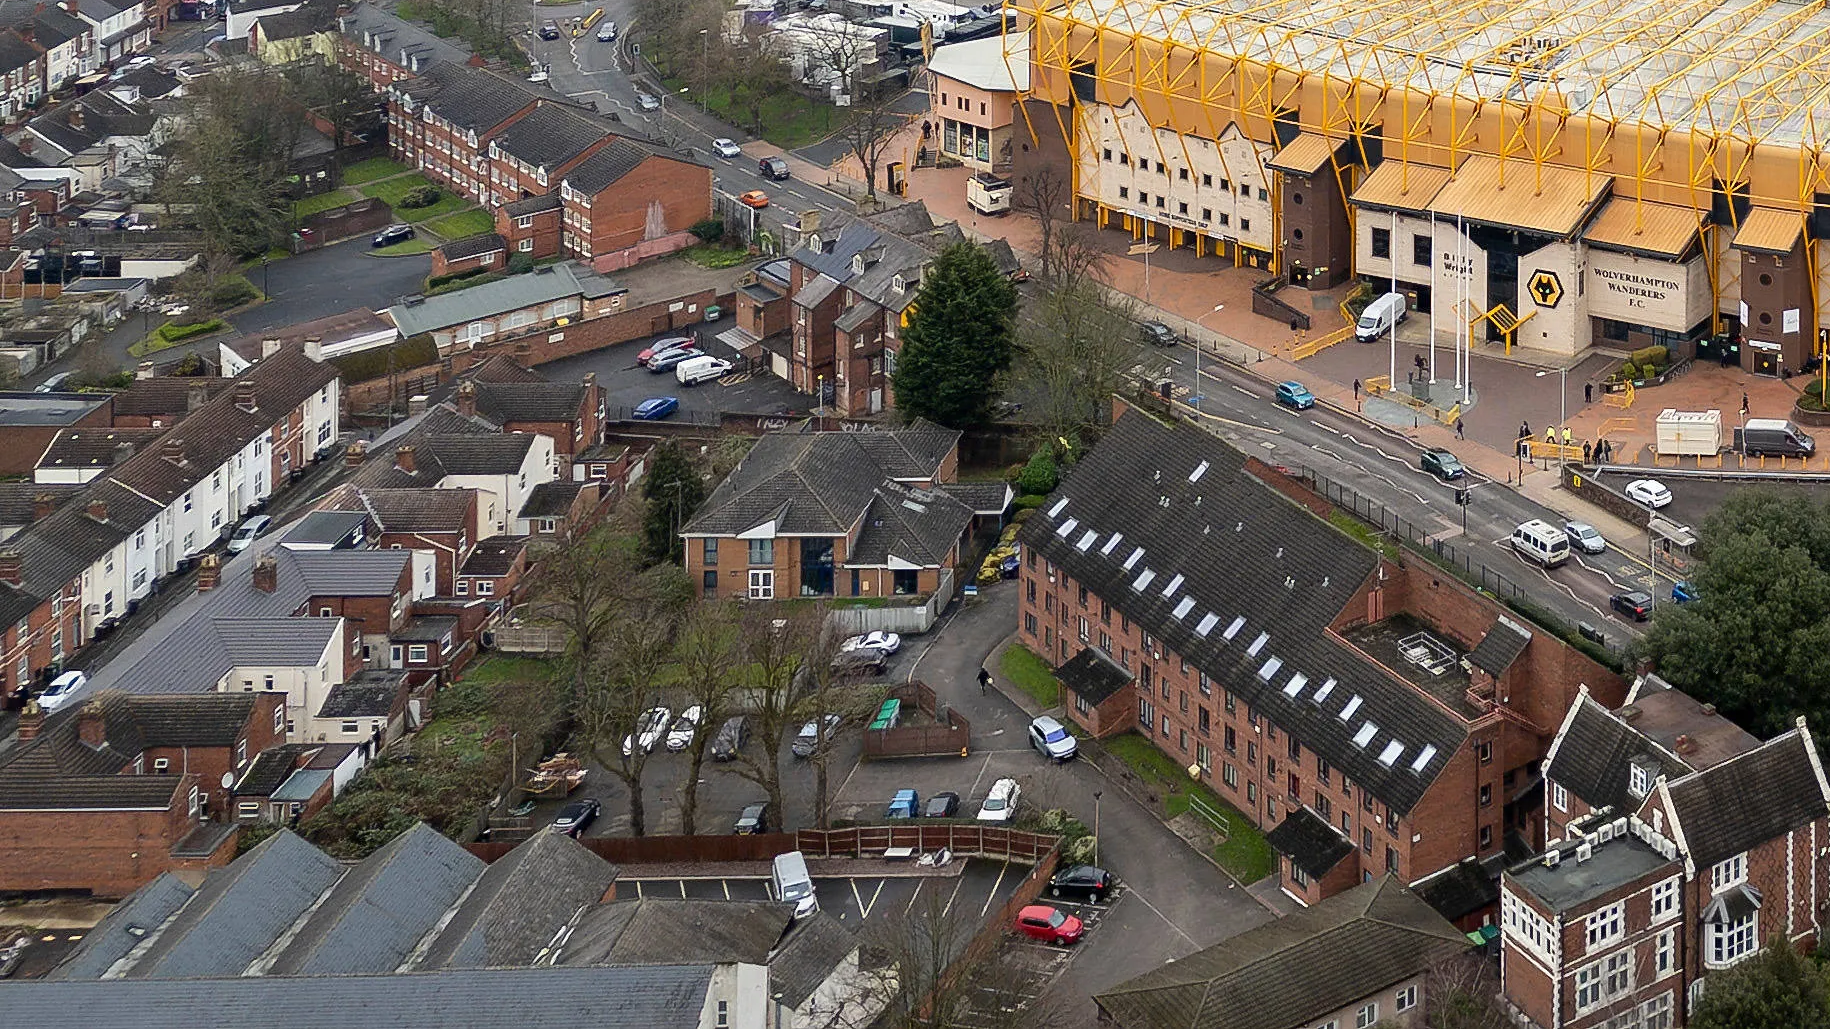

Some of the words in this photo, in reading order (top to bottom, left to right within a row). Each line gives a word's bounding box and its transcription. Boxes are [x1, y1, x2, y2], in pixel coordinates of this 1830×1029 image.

[1594, 267, 1680, 291] WOLVERHAMPTON
[1608, 283, 1666, 300] WANDERERS
[1628, 298, 1646, 309] F.C.
